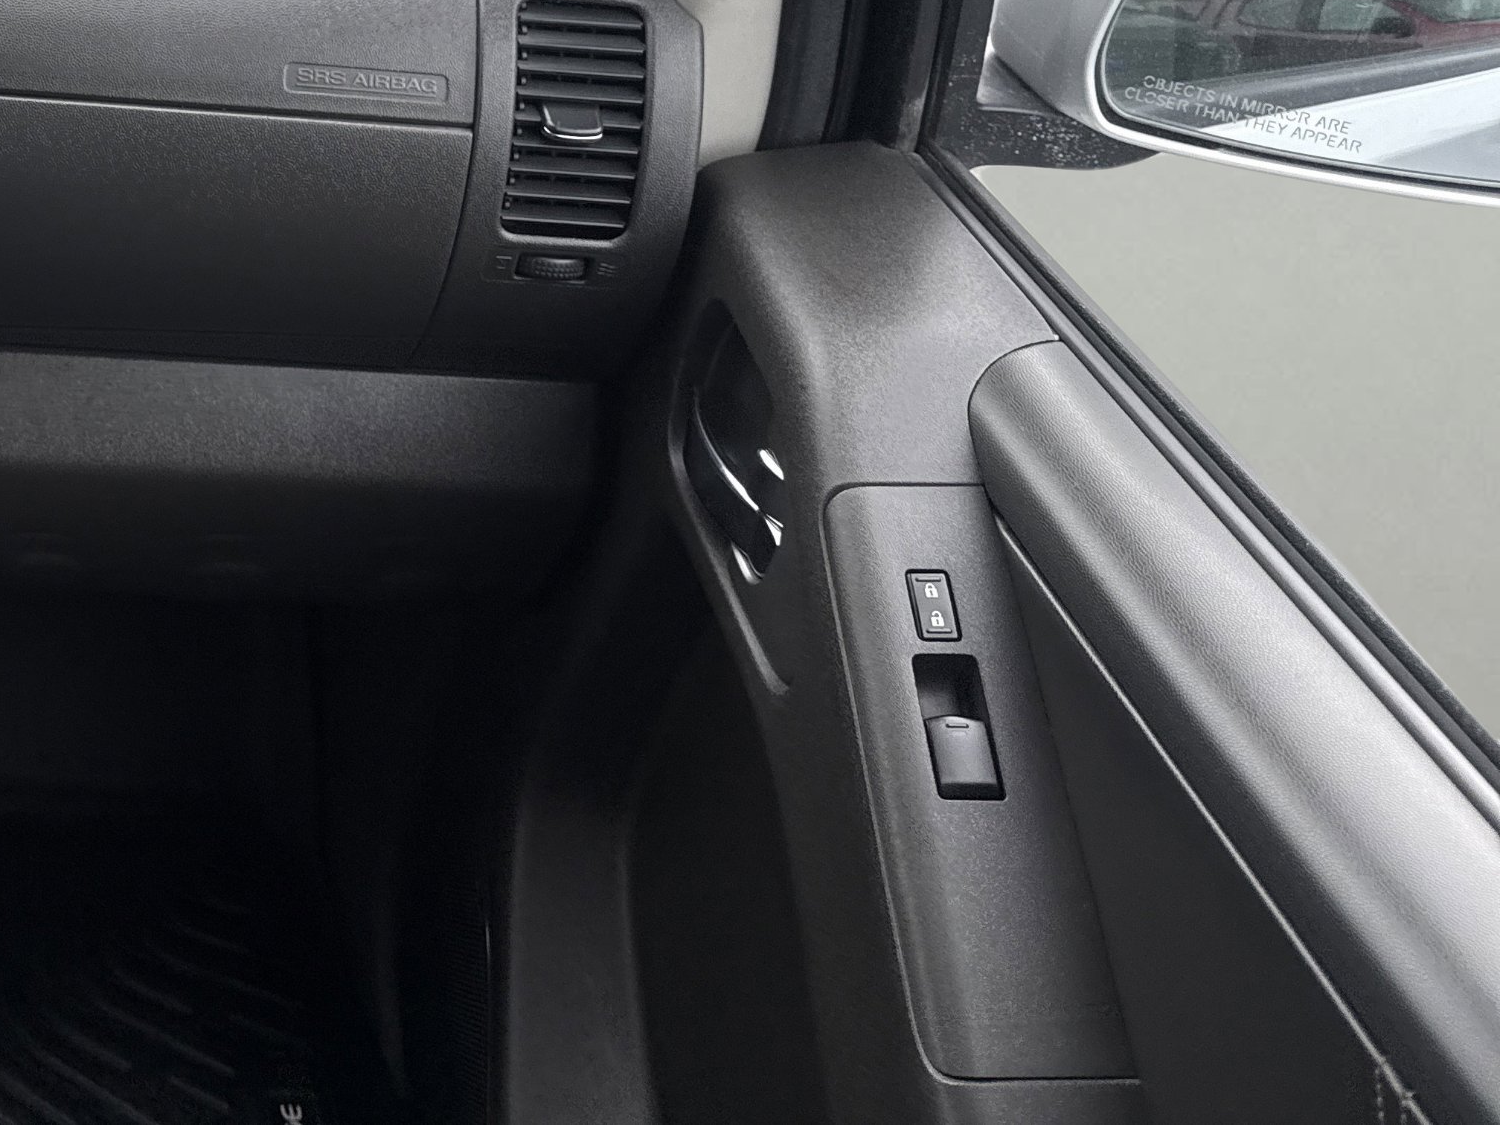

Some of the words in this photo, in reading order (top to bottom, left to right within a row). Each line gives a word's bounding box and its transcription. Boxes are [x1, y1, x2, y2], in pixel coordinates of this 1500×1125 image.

[296, 67, 347, 84] SRS
[352, 72, 438, 93] AIRBAG
[1143, 75, 1216, 102] OBJECTS
[1219, 92, 1239, 108] IN
[1240, 97, 1312, 125] MIRROR
[1314, 116, 1352, 135] ARE
[1124, 86, 1191, 112] CLOSER
[1194, 103, 1240, 124] THAN
[1243, 113, 1288, 136] THEY
[1290, 127, 1363, 154] APPEAR
